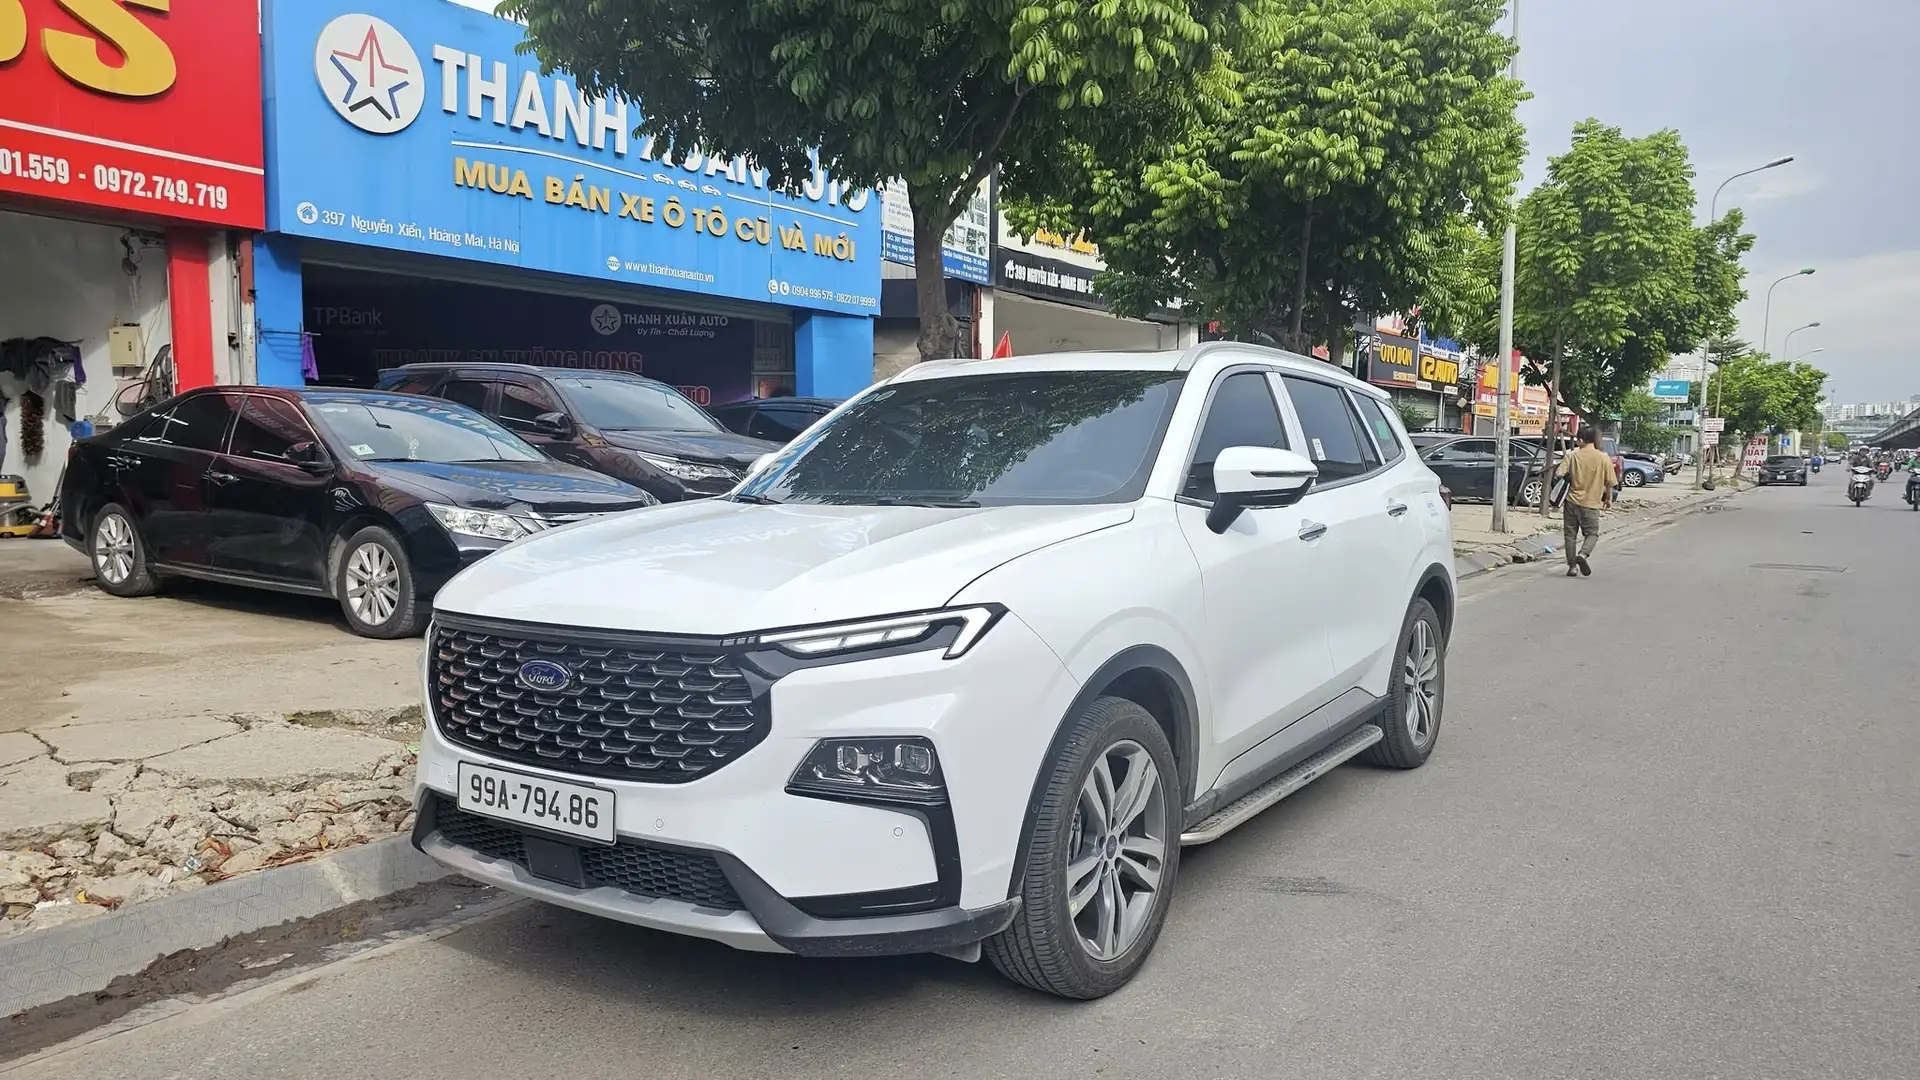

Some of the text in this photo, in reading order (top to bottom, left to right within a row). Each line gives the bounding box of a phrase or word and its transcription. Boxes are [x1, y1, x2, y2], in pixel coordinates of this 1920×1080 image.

[433, 44, 628, 154] THANH
[94, 164, 228, 210] 0972.749.719
[454, 157, 856, 262] MUA BÁN XE Ô TÔ CŨ VÀ MỚI
[322, 210, 345, 226] 397
[351, 215, 393, 234] Nguyễn
[429, 227, 461, 247] Hoàng
[465, 233, 486, 249] Mai,
[489, 235, 502, 250] Hà
[504, 240, 520, 254] Nội
[625, 262, 714, 284] www.thanhxuanauto.vn
[1014, 264, 1026, 281] 399
[792, 285, 808, 297] 0904
[313, 307, 382, 326] TPBank
[623, 312, 728, 327] THANH XUÂN AUTO
[637, 327, 648, 337] Uy
[583, 350, 643, 372] LONG
[1434, 360, 1458, 384] AUTO
[528, 666, 556, 685] Ford
[471, 773, 599, 828] 99A-794.86
